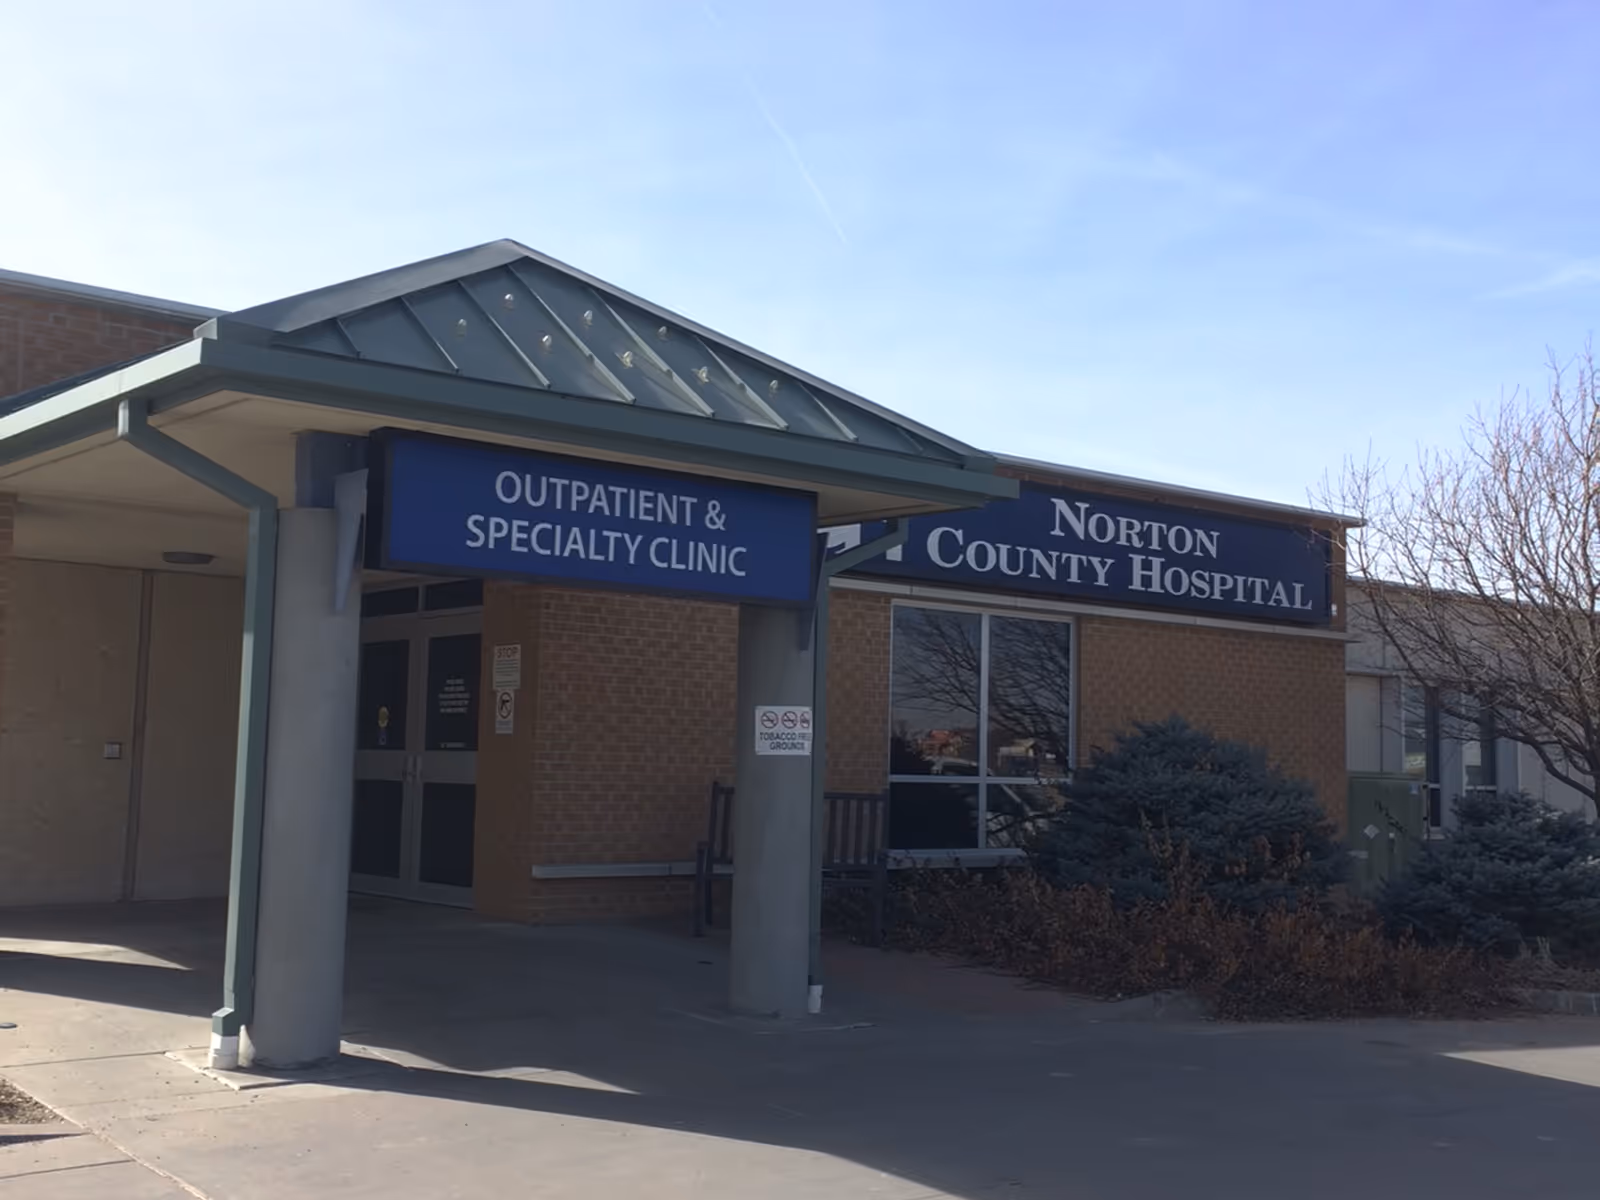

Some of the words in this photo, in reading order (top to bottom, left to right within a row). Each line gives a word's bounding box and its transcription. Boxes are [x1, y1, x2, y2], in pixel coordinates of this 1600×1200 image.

[495, 471, 697, 527] OUTPATIENT
[704, 499, 727, 531] &
[1051, 498, 1220, 559] NORTON
[466, 514, 643, 565] SPECIALTY
[649, 537, 747, 576] CLINIC
[926, 526, 1115, 587] COUNTY
[1129, 554, 1313, 611] HOSPITAL
[759, 732, 797, 741] TOBACCO
